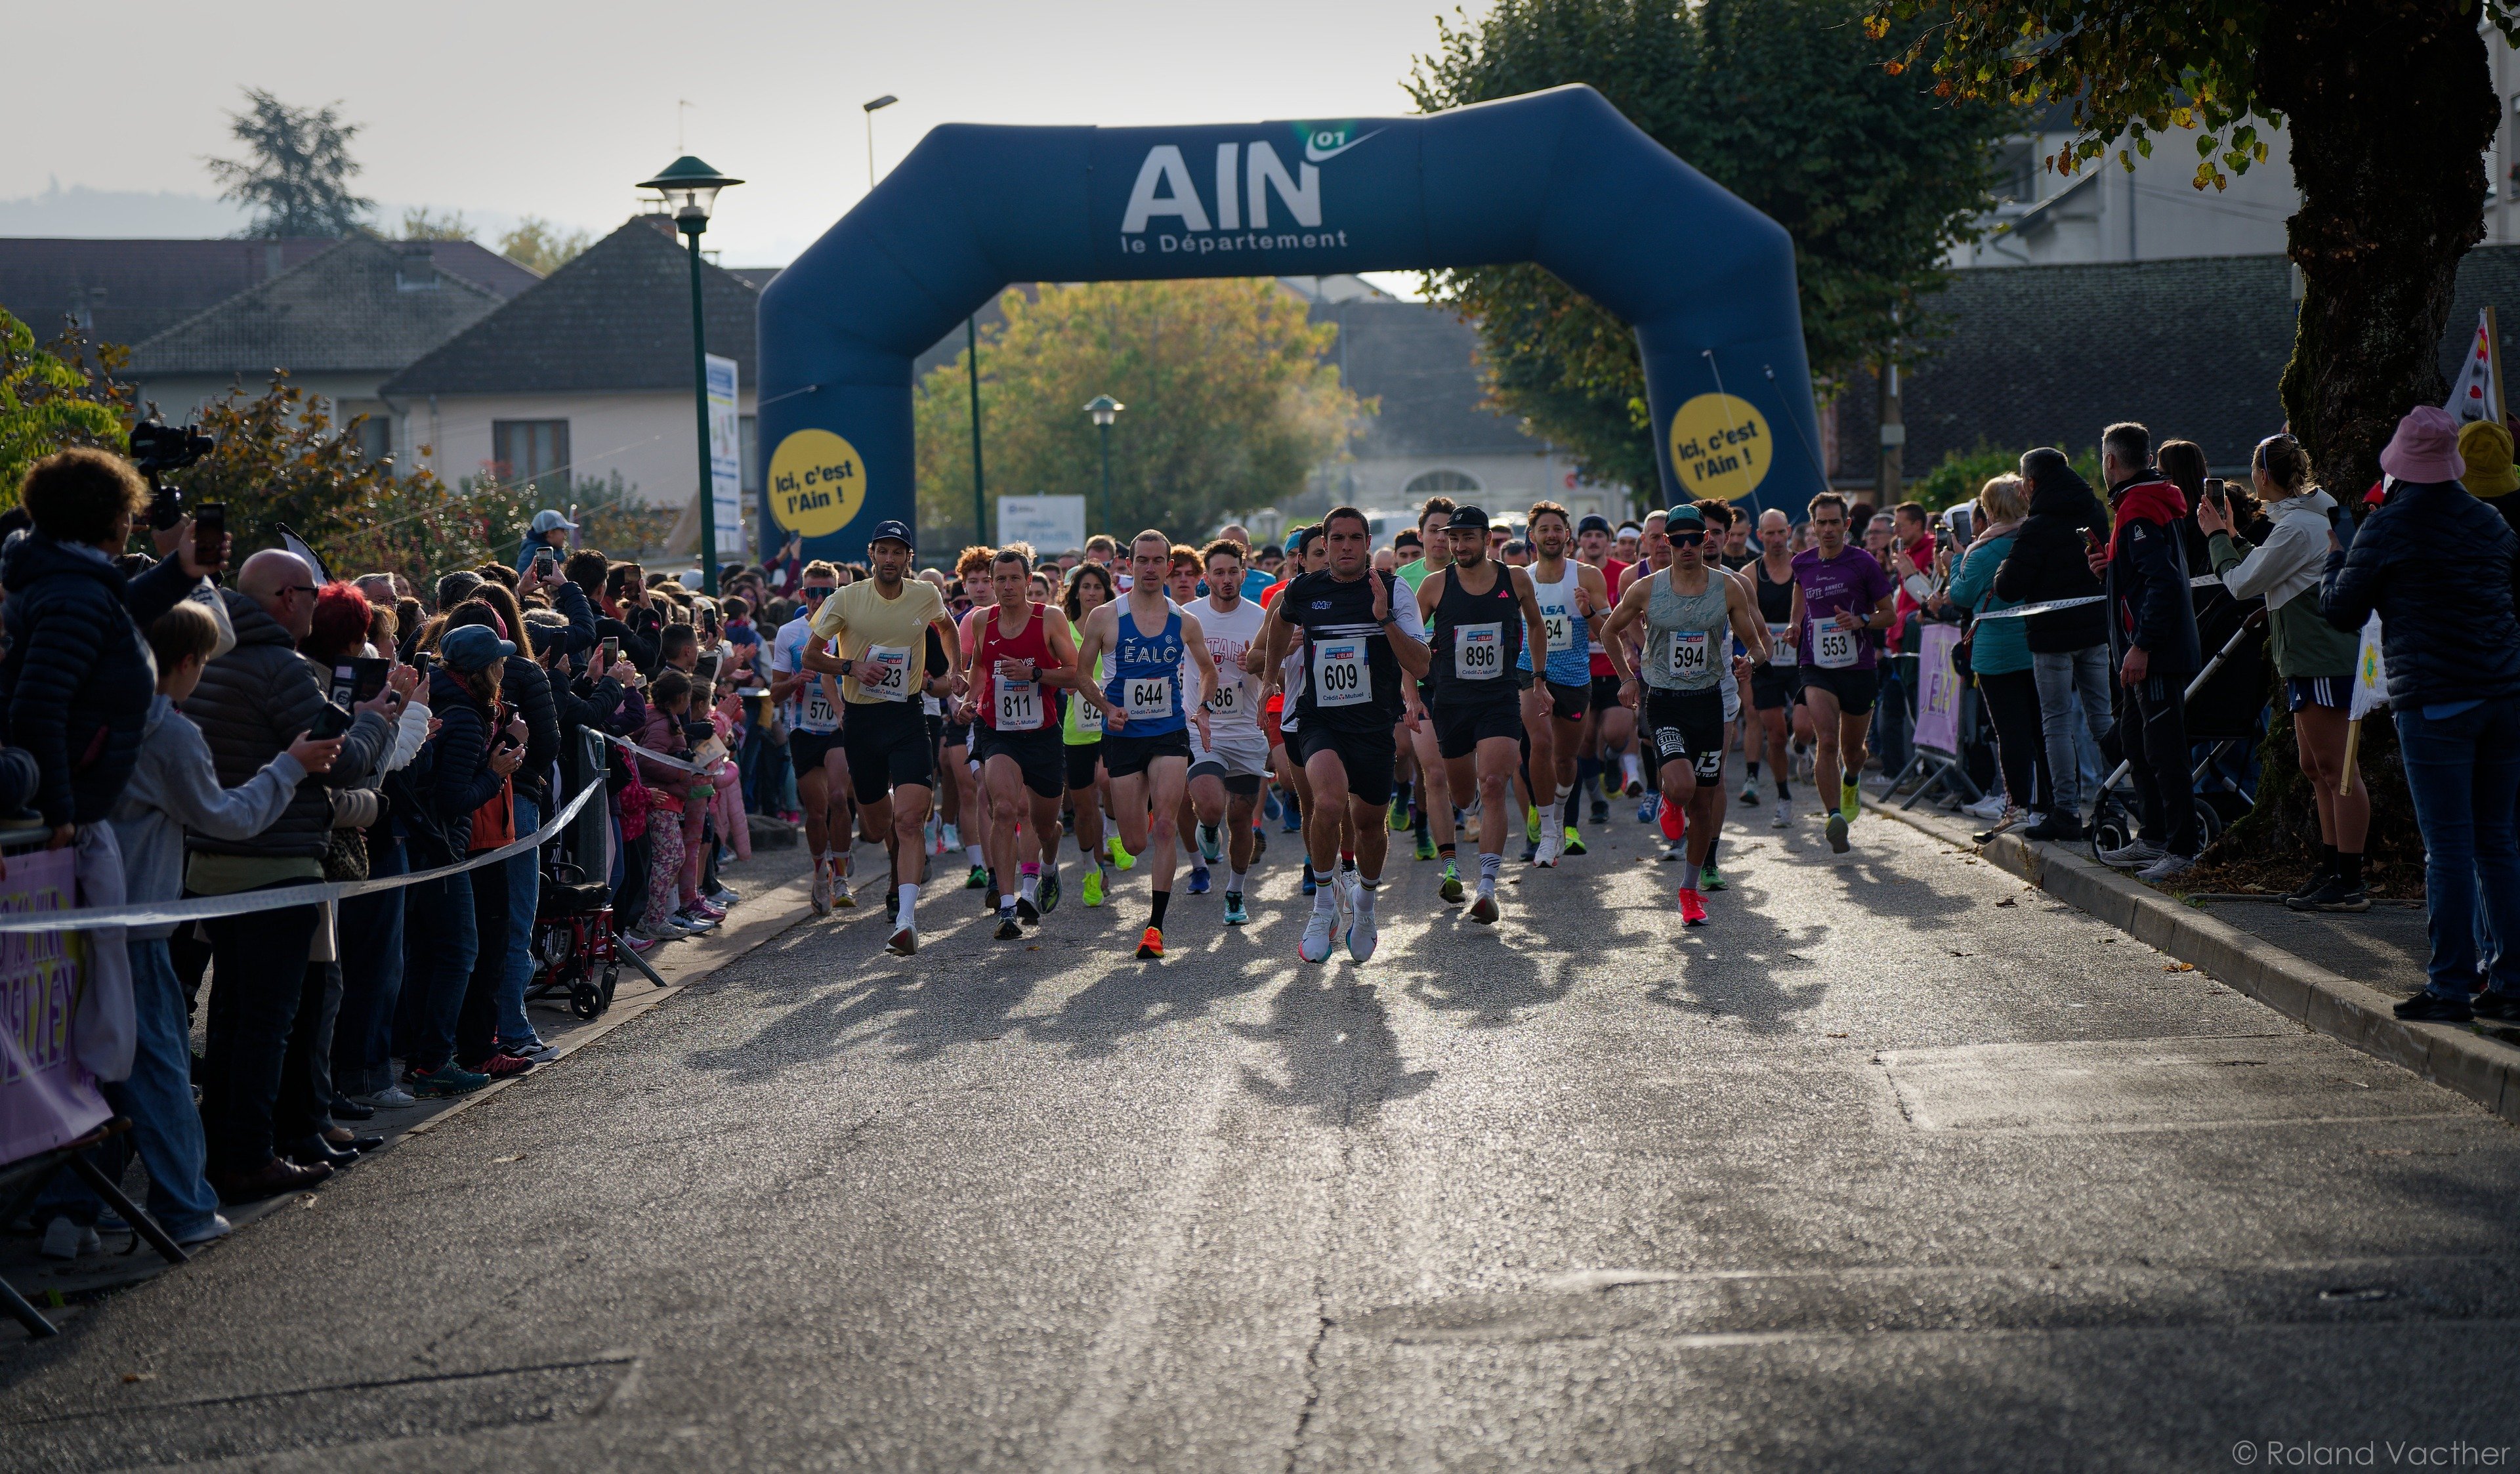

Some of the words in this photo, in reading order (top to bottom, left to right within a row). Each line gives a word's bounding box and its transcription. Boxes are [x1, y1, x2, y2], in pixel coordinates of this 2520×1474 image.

[1316, 131, 1346, 147] 01
[1120, 140, 1323, 234] AIN
[1121, 235, 1147, 254] le
[1159, 230, 1349, 255] Département
[1677, 438, 1706, 461] Ici,
[1708, 420, 1759, 451] c'est
[775, 472, 801, 494] Ici,
[805, 459, 855, 486] c'est
[1694, 454, 1739, 481] l'Ain
[788, 491, 831, 515] l'Ain
[1545, 619, 1563, 639] 64
[1124, 646, 1177, 663] EALC
[1204, 637, 1243, 663] TAH
[1466, 645, 1494, 666] 896
[1674, 646, 1704, 668] 594
[1773, 639, 1787, 656] 17
[1822, 635, 1847, 657] 553
[880, 667, 902, 688] 23
[1325, 663, 1358, 690] 609
[1135, 683, 1163, 706] 644
[1213, 687, 1233, 707] 86
[810, 702, 834, 721] 570
[1004, 695, 1031, 717] 811
[1083, 701, 1101, 720] 92
[0, 958, 77, 1086] ELLEY
